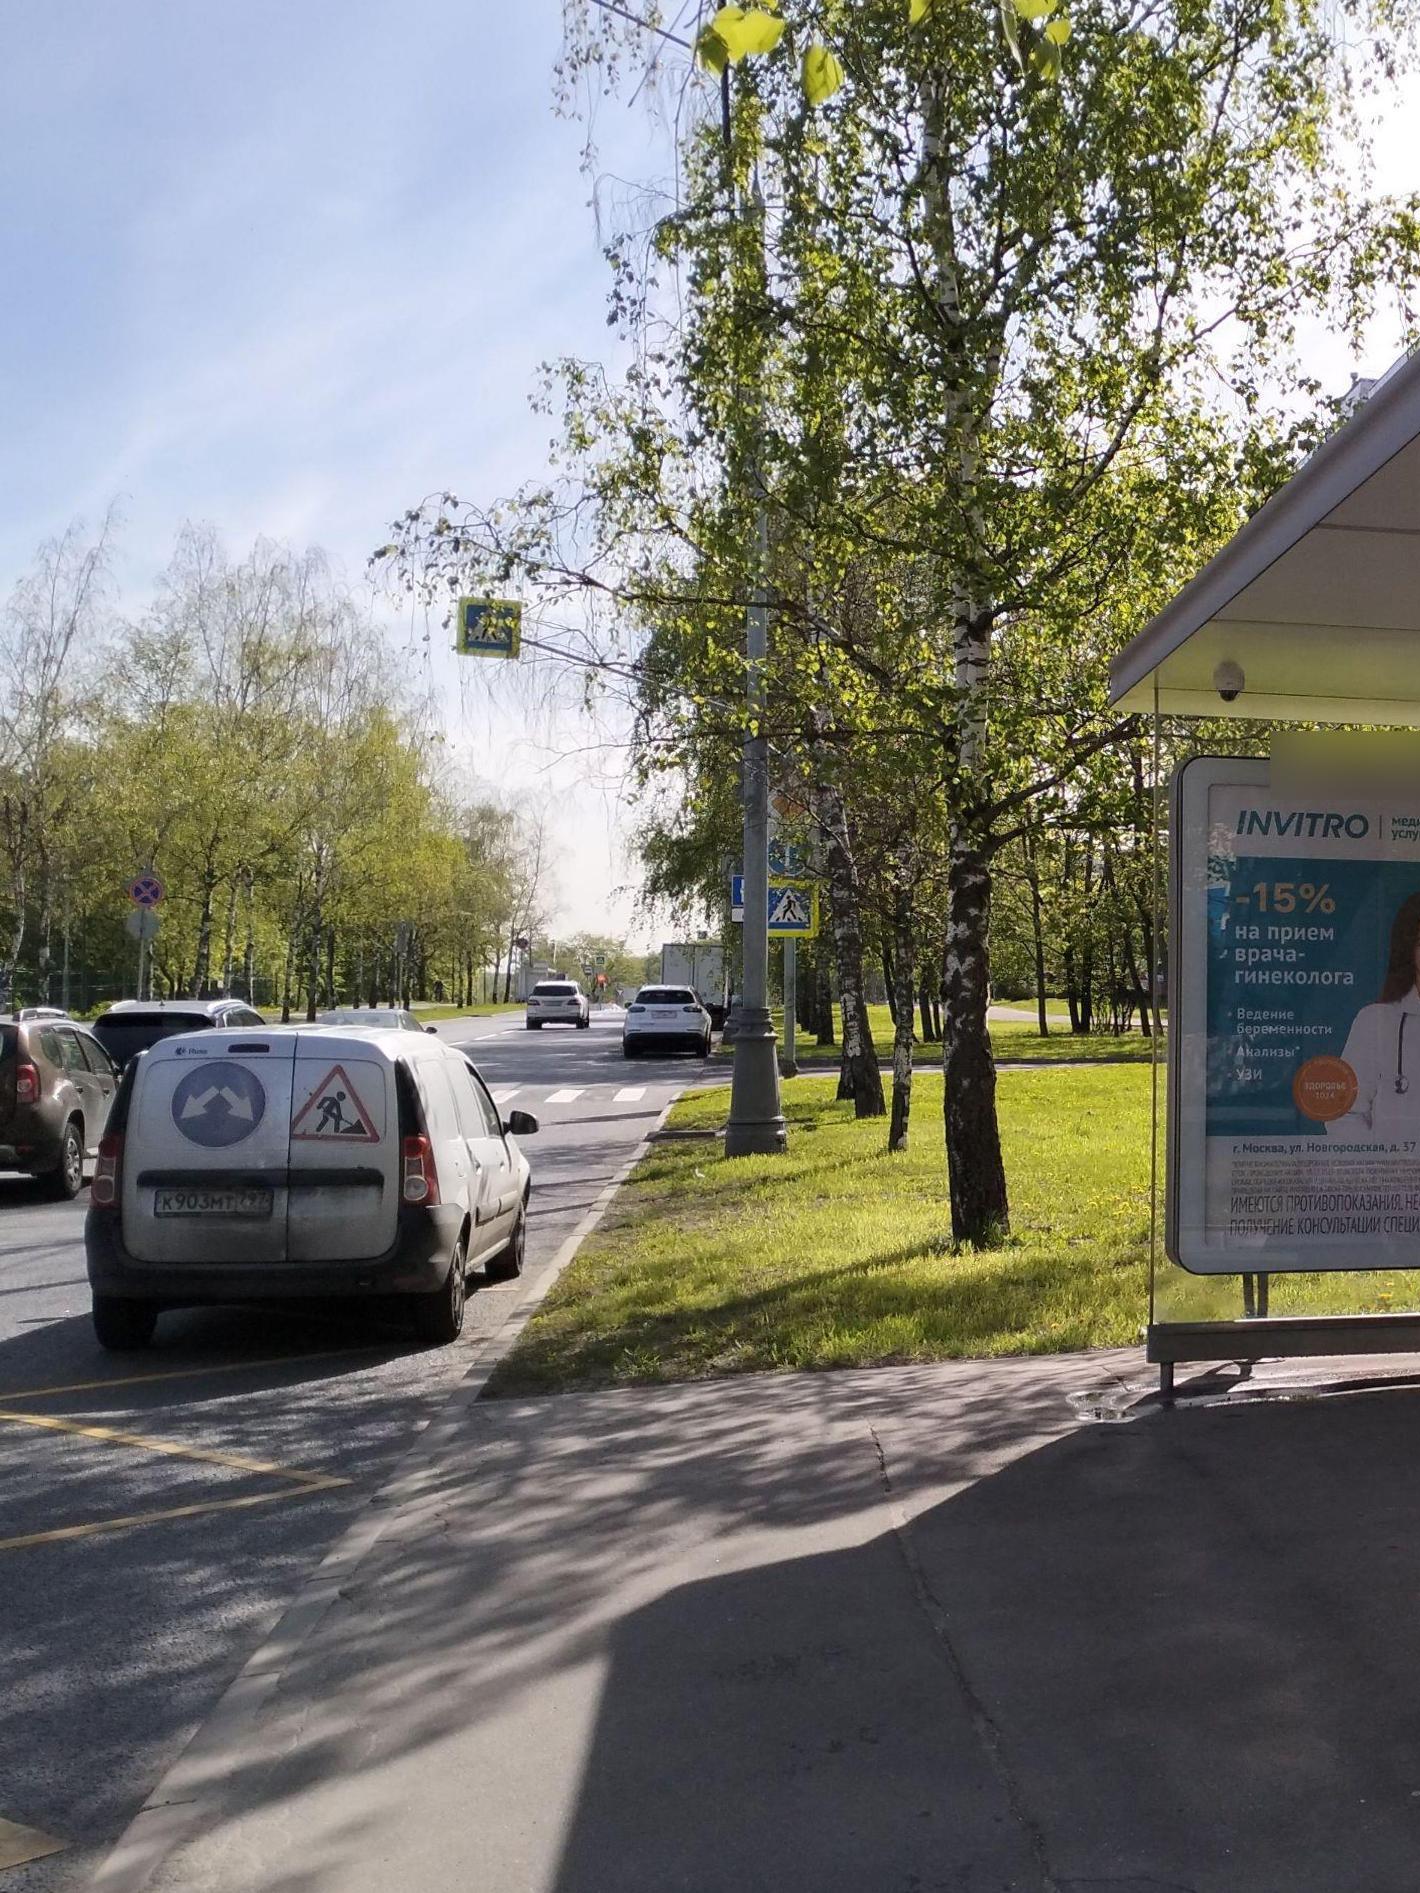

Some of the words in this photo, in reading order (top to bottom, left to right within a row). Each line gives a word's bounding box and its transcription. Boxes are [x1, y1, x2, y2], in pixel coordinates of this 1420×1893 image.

[1236, 809, 1369, 839] INVITRO
[1236, 881, 1336, 914] -15%
[1235, 926, 1260, 941] на
[1267, 925, 1334, 944] прием
[1235, 947, 1306, 966] врача-
[1235, 969, 1354, 986] гинеколога
[1236, 1008, 1295, 1022] Ведение
[1236, 1022, 1333, 1038] беременности
[1236, 1068, 1263, 1081] УЗИ
[1242, 1143, 1287, 1154] Москва,
[1290, 1144, 1304, 1155] ул.
[1230, 1194, 1284, 1214] ИМЕЮТСЯ
[1229, 1217, 1294, 1236] ПОЛУЧЕНИЕ
[1297, 1216, 1381, 1235] КОНСУЛЬТАЦИИ
